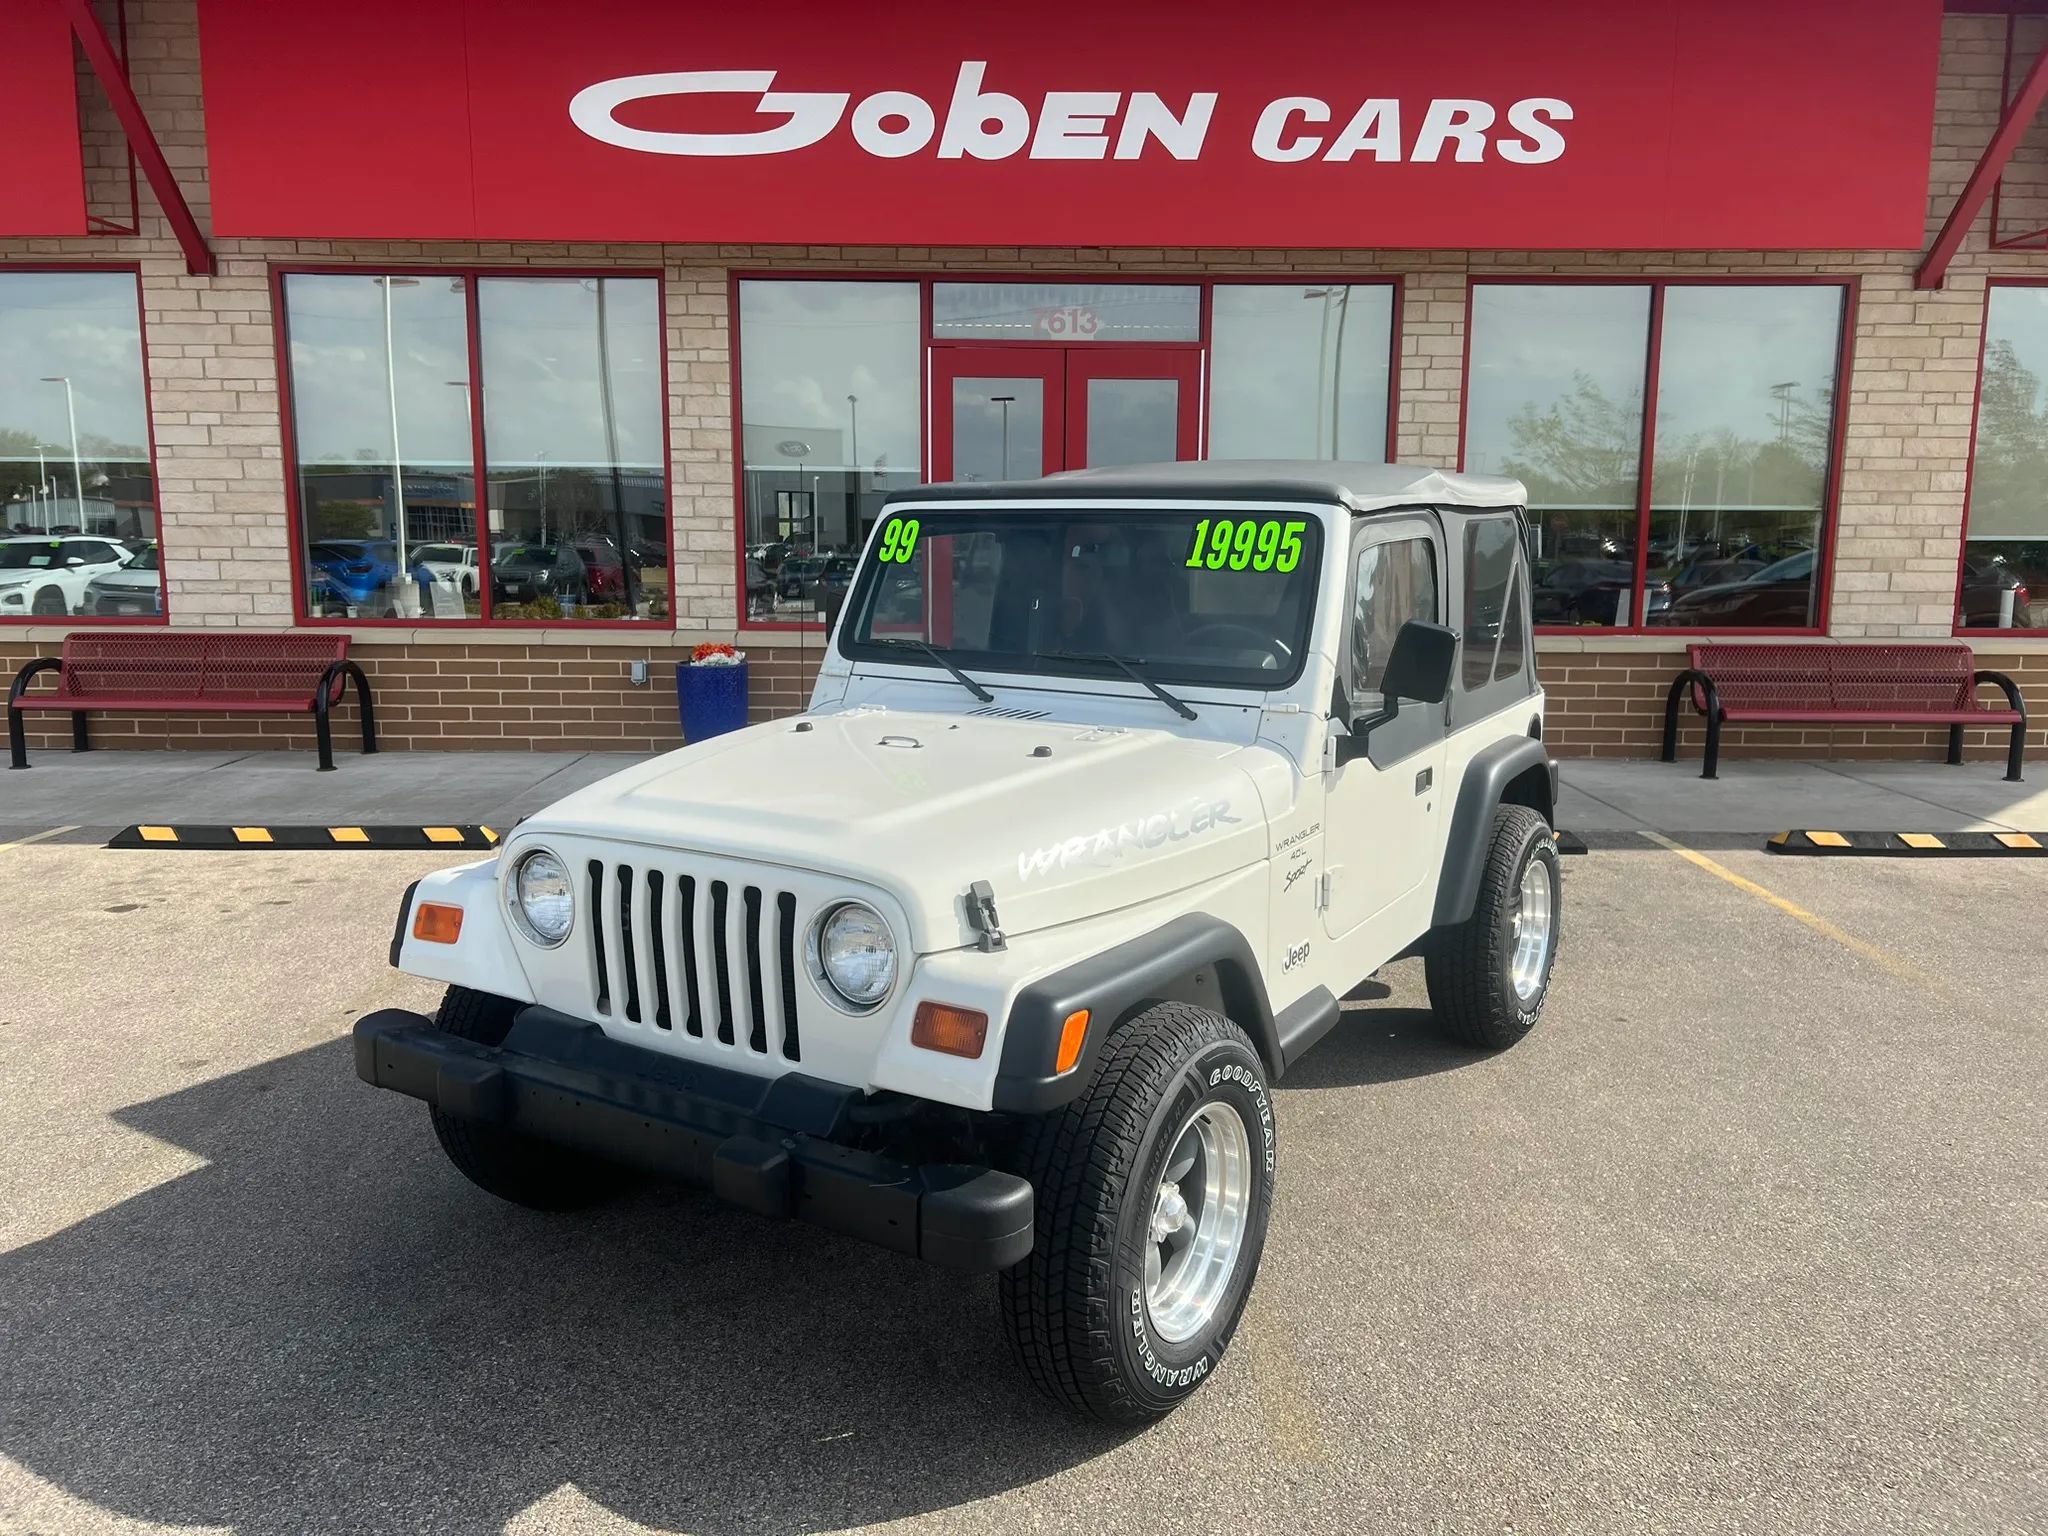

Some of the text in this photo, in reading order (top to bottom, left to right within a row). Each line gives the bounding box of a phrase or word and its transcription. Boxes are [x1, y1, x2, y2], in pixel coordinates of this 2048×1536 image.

[1251, 96, 1574, 164] CARS
[878, 518, 920, 564] 99
[1185, 518, 1307, 573] 19995
[1018, 797, 1242, 881] WRANGLER
[1275, 822, 1320, 852] WRANGLER
[1283, 941, 1310, 971] Jeep
[1204, 1064, 1275, 1173] GOODYEAR
[1131, 1287, 1209, 1387] WRANGLER
